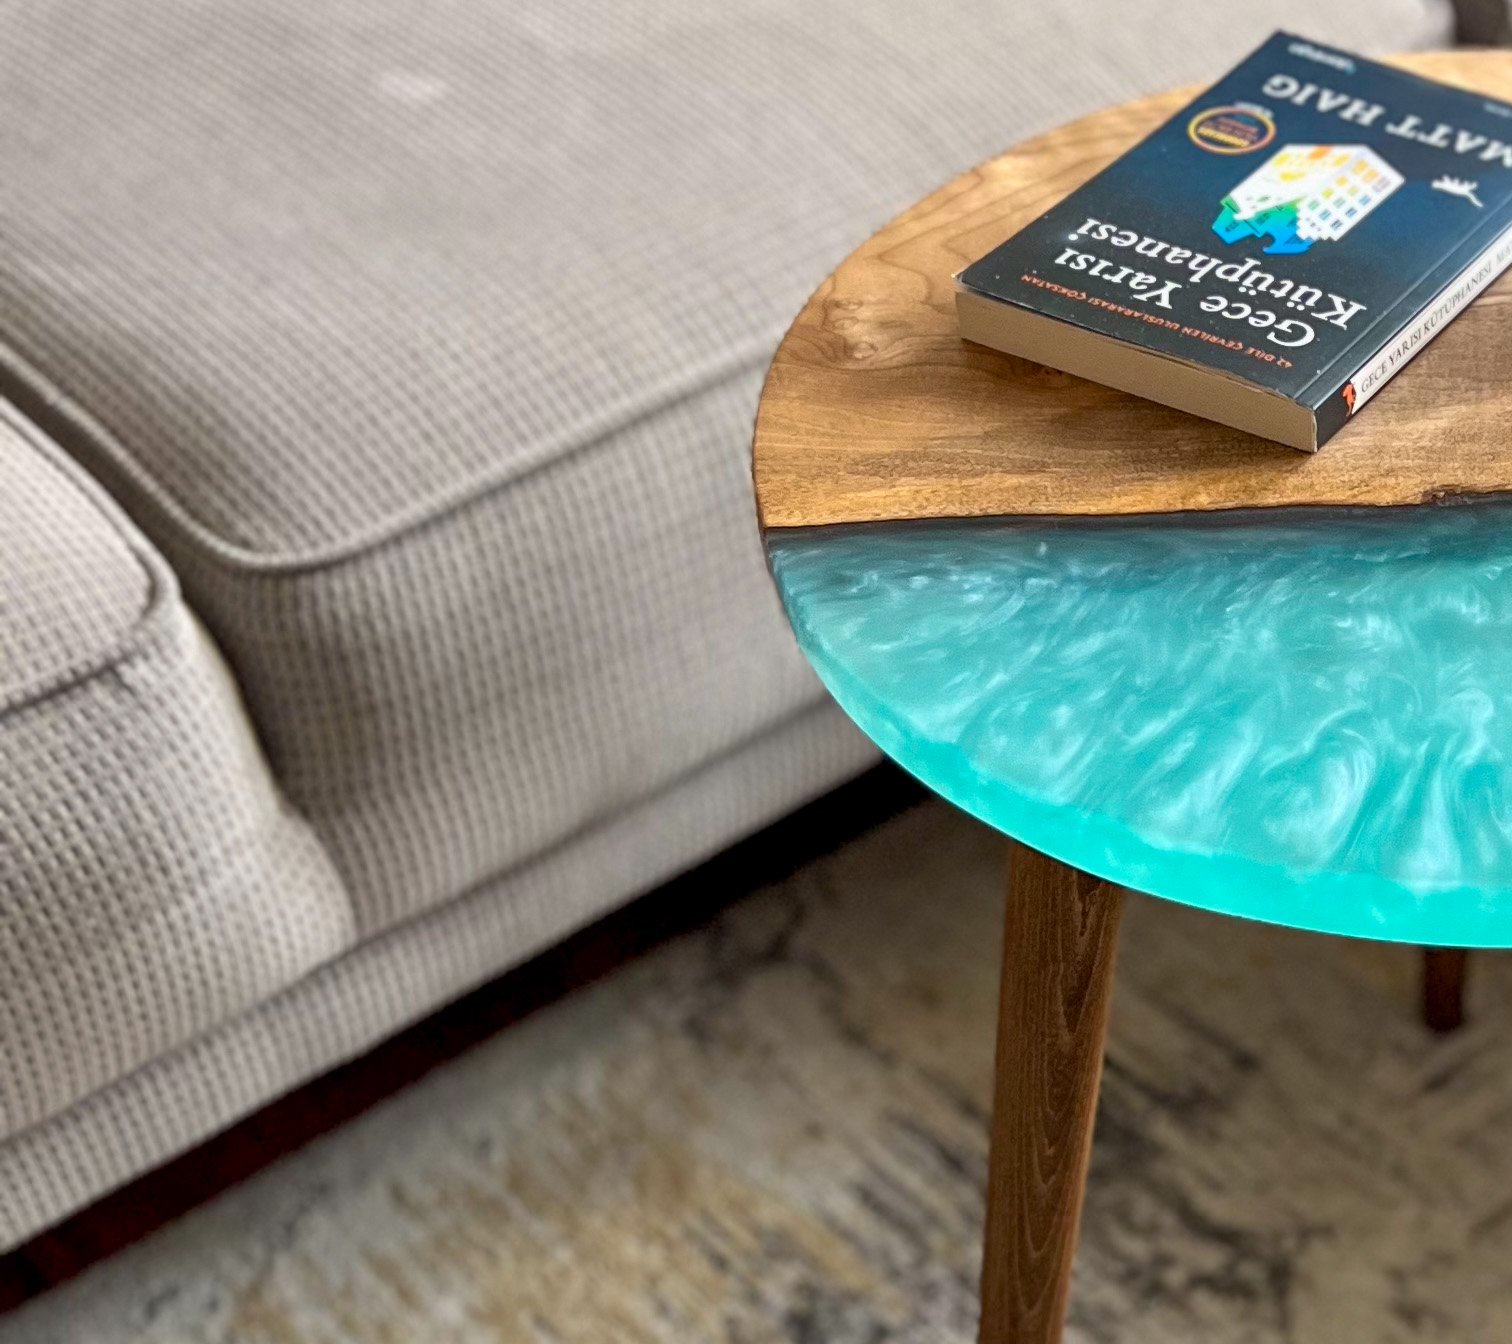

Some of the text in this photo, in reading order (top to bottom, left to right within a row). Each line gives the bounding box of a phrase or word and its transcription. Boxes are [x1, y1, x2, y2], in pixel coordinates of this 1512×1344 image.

[1262, 74, 1386, 127] HAIG
[1054, 248, 1315, 348] Gece Yarısı
[1067, 218, 1367, 331] Kütüphanesi
[1087, 297, 1180, 330] ULUSLARARASI
[1247, 347, 1276, 362] DİLE
[1361, 361, 1388, 394] GECE
[1389, 328, 1423, 365] YARISI
